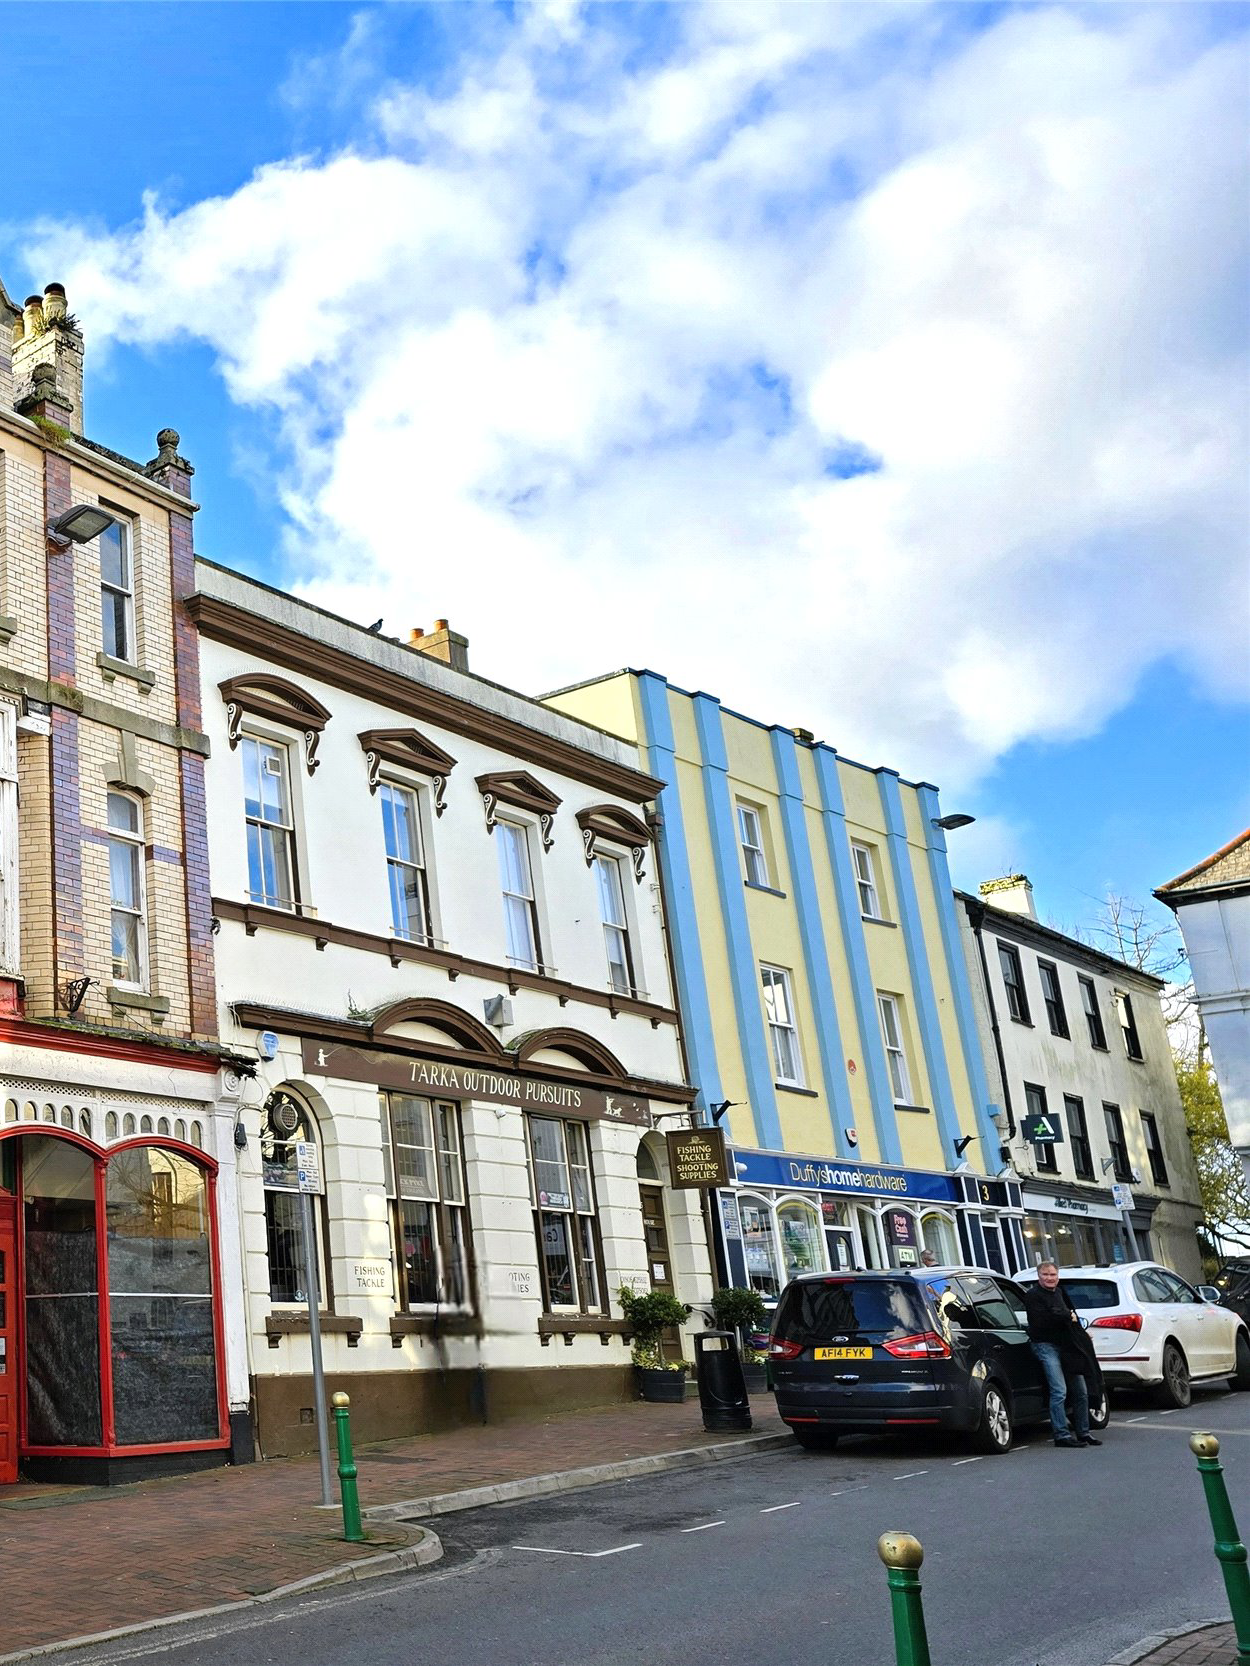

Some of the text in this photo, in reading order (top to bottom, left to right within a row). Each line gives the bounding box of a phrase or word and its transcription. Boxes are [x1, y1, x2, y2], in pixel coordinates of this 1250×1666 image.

[409, 1061, 582, 1108] TARKA OUTDOOR PURSUITS
[676, 1145, 712, 1155] FISHING
[679, 1153, 711, 1162] TACKLE
[676, 1163, 719, 1172] SHOOTING
[679, 1171, 717, 1180] SUPPLIES
[981, 1185, 990, 1200] 3
[354, 1265, 386, 1276] FISHING
[357, 1278, 385, 1288] TACKLE
[821, 1347, 866, 1358] AF14 FYK
